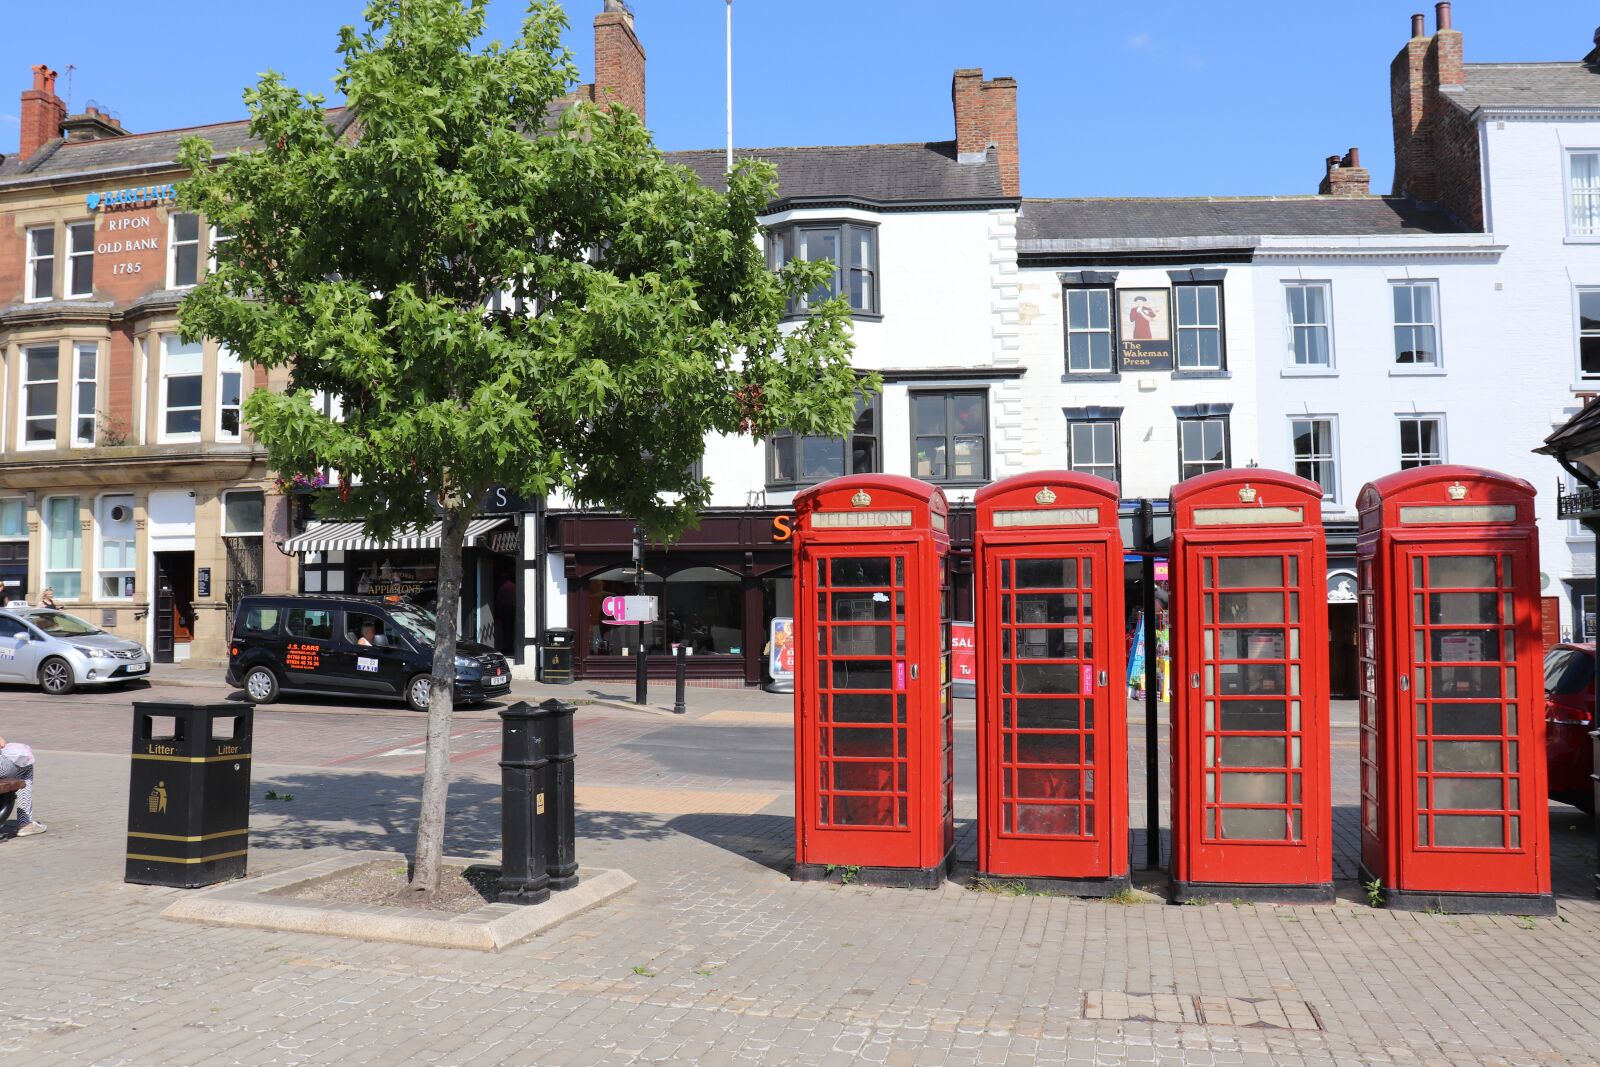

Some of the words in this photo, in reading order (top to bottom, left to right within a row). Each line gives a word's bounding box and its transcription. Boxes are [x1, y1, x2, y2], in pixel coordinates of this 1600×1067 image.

[104, 184, 177, 205] BARCLAYS
[109, 216, 150, 231] RIPON
[97, 242, 122, 254] OLD
[125, 238, 158, 251] BANK
[113, 262, 141, 275] 1785
[1122, 341, 1141, 350] The
[1122, 350, 1169, 358] Wakeman
[1123, 357, 1151, 366] Press
[287, 643, 300, 651] J.S.
[301, 644, 320, 652] CARS
[960, 664, 971, 675] Tu
[148, 743, 176, 755] Litter
[218, 745, 239, 755] Litter
